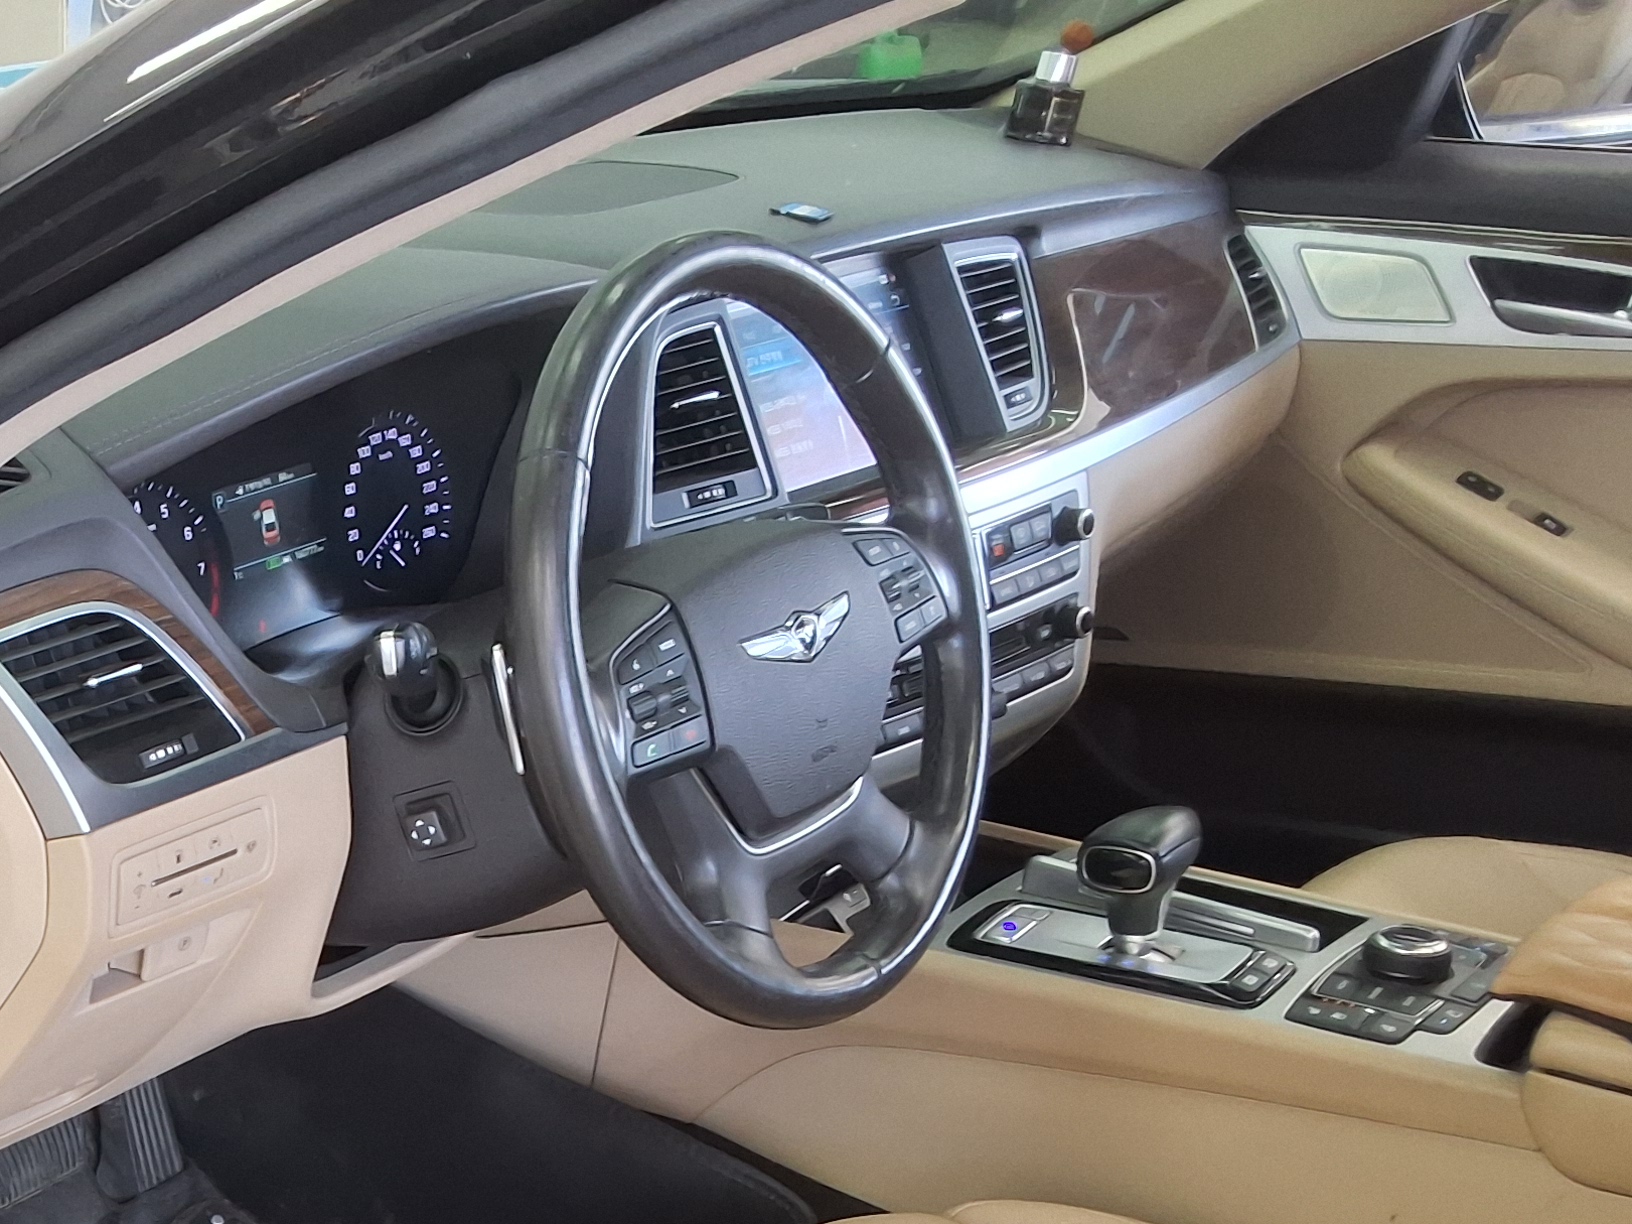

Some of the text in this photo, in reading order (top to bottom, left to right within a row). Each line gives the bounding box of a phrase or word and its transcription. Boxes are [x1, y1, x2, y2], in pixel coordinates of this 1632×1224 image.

[159, 503, 169, 519] 5
[183, 526, 193, 541] 6
[197, 561, 206, 576] 7
